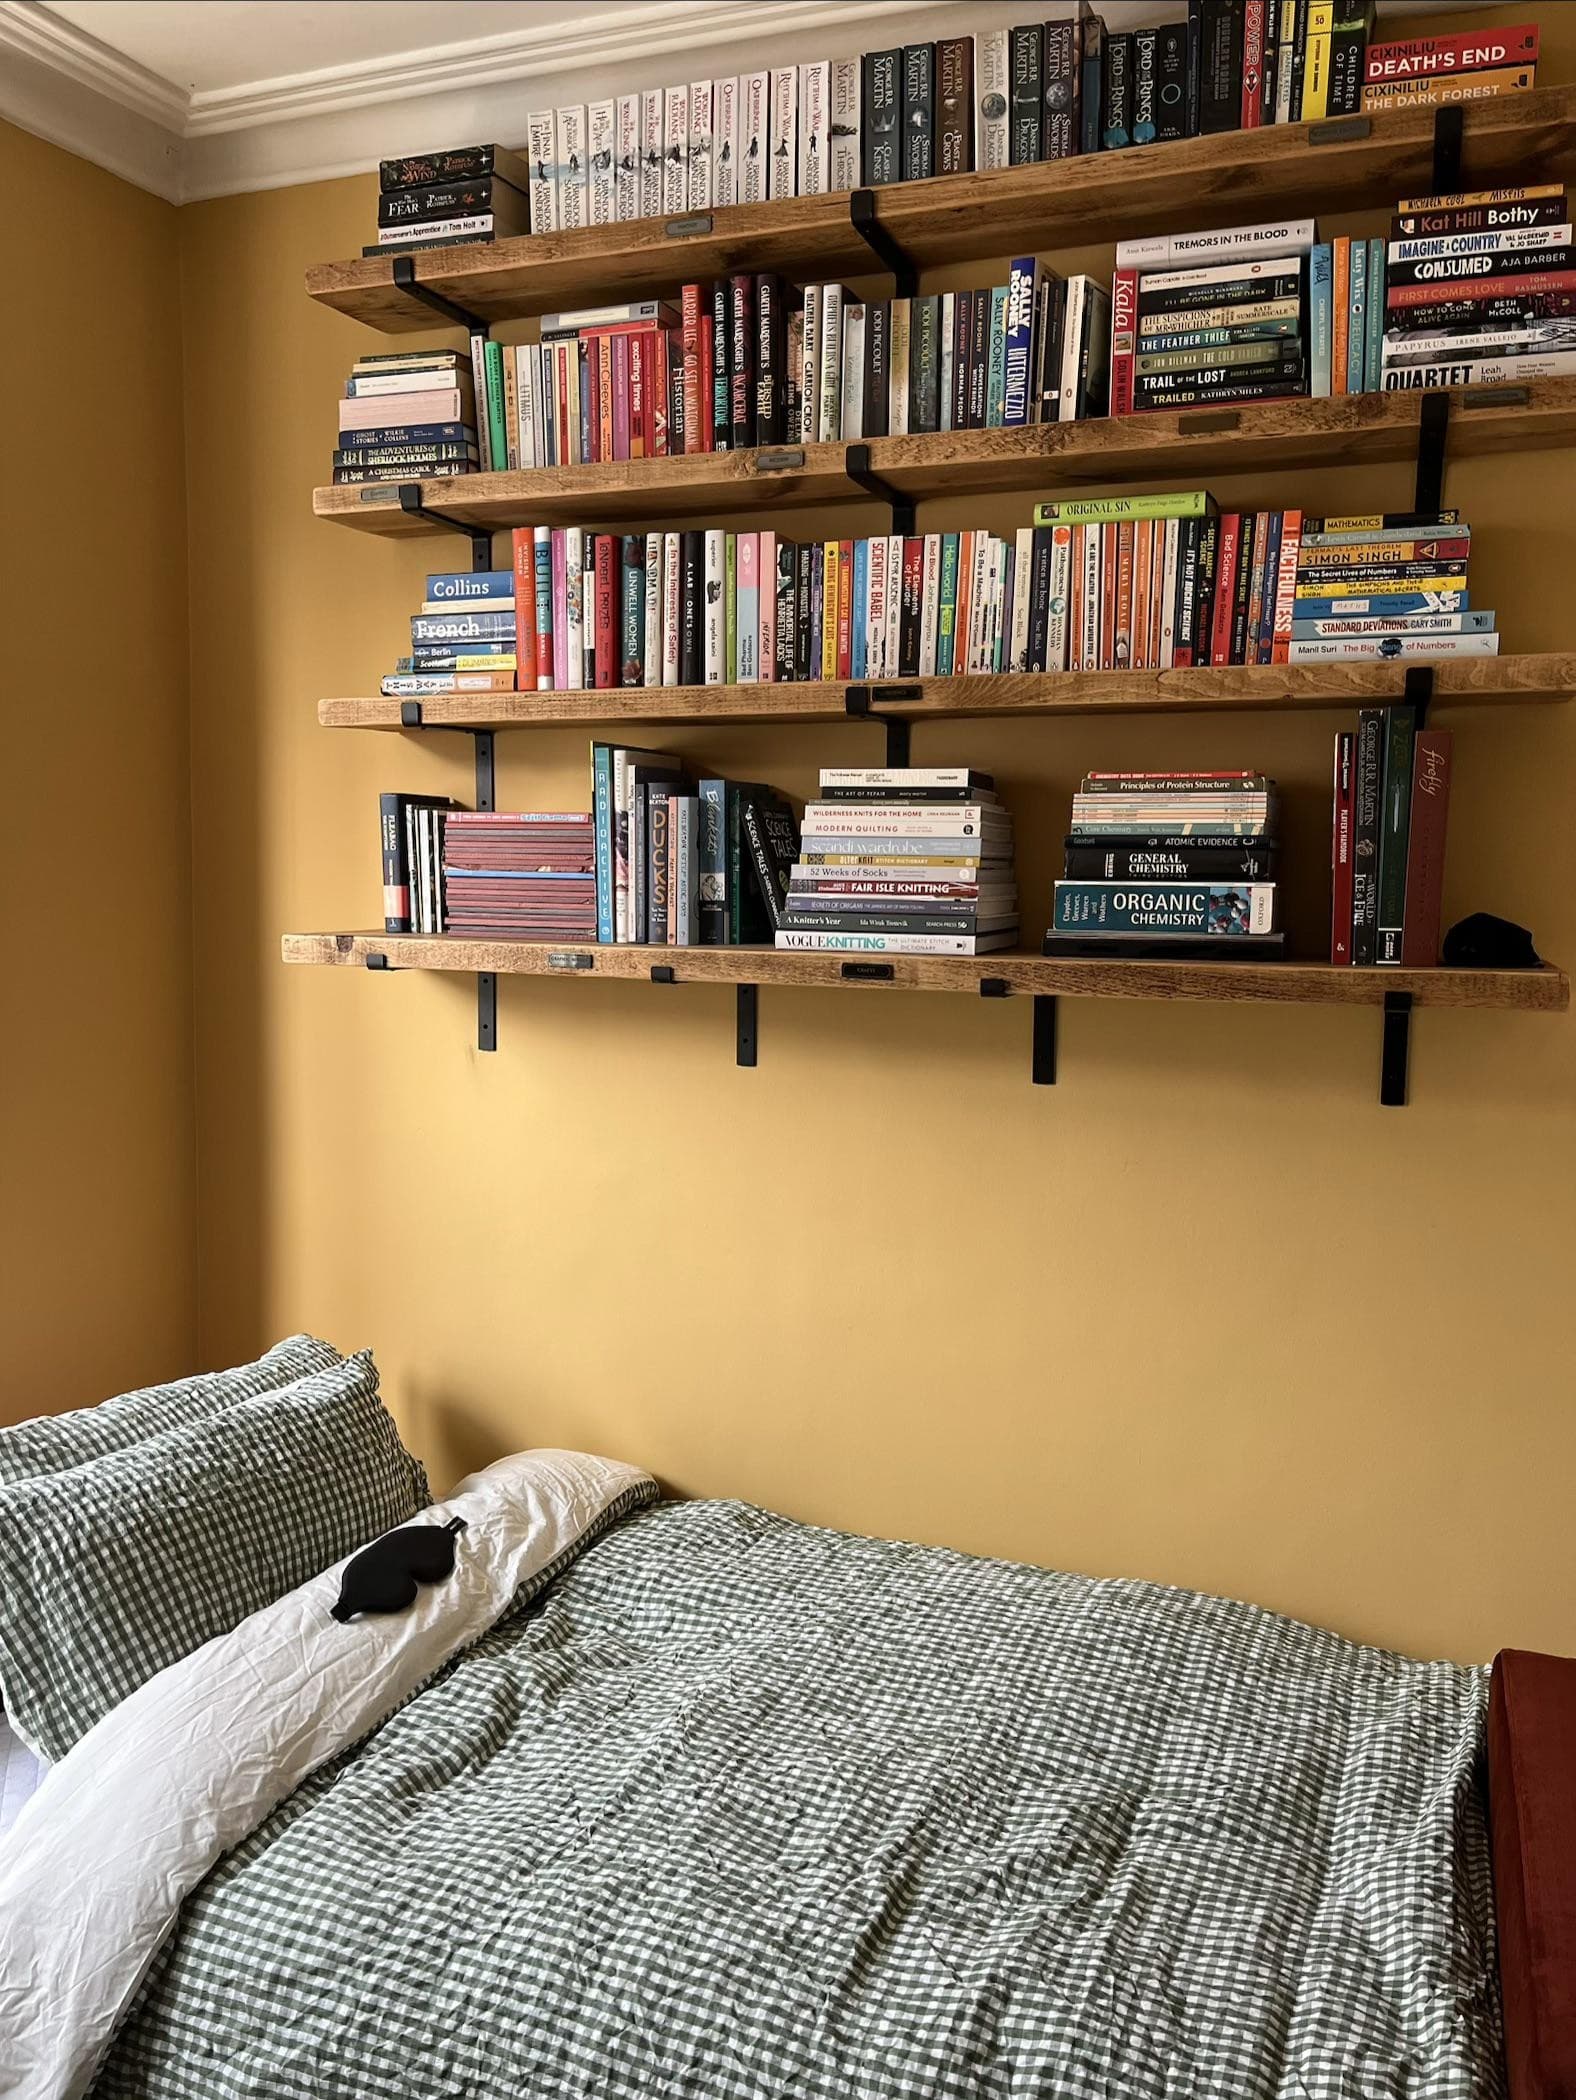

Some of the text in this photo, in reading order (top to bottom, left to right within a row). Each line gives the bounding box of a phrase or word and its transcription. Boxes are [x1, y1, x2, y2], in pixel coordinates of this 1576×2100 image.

[1315, 15, 1324, 25] 50
[1248, 4, 1261, 65] POWER
[1017, 32, 1028, 84] MARTIN
[1050, 28, 1063, 80] MARTIN
[1369, 46, 1506, 77] DEATH'S END
[908, 51, 920, 102] MARTIN
[943, 45, 954, 97] MARTIN
[1136, 36, 1155, 123] LORD RINGS
[1333, 53, 1344, 103] OF TIME
[1345, 46, 1358, 109] CHILDREN
[838, 64, 848, 115] MARTIN
[874, 59, 885, 109] MARTIN
[1365, 85, 1499, 110] THE DARK FOREST
[943, 132, 953, 171] CROWS
[837, 146, 847, 191] THRONE
[543, 187, 551, 231] BRANDON
[1421, 206, 1539, 232] Kat Hill Bothy
[449, 221, 476, 231] Tom Holt
[1174, 237, 1218, 251] TREMORS
[1220, 235, 1231, 245] IN
[1234, 232, 1252, 242] THE
[1254, 229, 1288, 240] BLOOD
[1399, 234, 1502, 259] IMAGINE COUNTRY
[1414, 253, 1566, 279] CONSUMED AJA BARBER
[1008, 269, 1021, 338] ROONEY
[1019, 275, 1032, 328] SALLY
[1115, 279, 1134, 329] Kala
[1399, 283, 1505, 302] FIRST COMES LOVE
[992, 297, 1003, 376] SALLY ROONEY
[1141, 330, 1231, 351] THE FEATHER THIEF
[1351, 318, 1363, 375] DELICACY
[1395, 340, 1446, 351] PAPYRUS
[873, 334, 882, 375] PICOULT
[631, 341, 642, 412] exciting times
[1143, 370, 1226, 390] TRAIL LOST
[1386, 365, 1473, 390] QUARTET
[1481, 366, 1502, 375] Leah
[1005, 347, 1027, 420] INTERMEZZO
[520, 384, 531, 422] LITMUS
[1152, 392, 1195, 404] TRAILED
[1067, 501, 1131, 515] ORIGINAL SIN
[1327, 518, 1381, 529] MATHEMATICS
[1222, 535, 1233, 586] Bad Science
[1306, 551, 1401, 565] SIMON SINGH
[434, 579, 490, 597] Collins
[871, 543, 884, 622] SCIENTIFIC BABEL
[911, 574, 920, 616] Elements
[1275, 539, 1299, 633] FACTFULNESS
[628, 571, 638, 656] UNWELL WOMEN
[1322, 620, 1362, 633] STANDARD
[1363, 619, 1408, 632] DEVIATIONS
[416, 616, 480, 639] French
[431, 648, 452, 656] Berlin
[1361, 644, 1375, 653] Big
[1407, 641, 1456, 650] of Numbers
[1419, 747, 1445, 797] firefly
[1120, 780, 1230, 790] Principles of Protein Structure
[856, 825, 898, 833] QUILTING
[1165, 838, 1238, 846] ATOMIC EVIDENCE
[653, 809, 666, 905] DUCKS
[1128, 863, 1189, 874] CHEMISTRY
[1129, 853, 1181, 864] GENERAL
[810, 868, 888, 877] 52 Weeks of Socks
[851, 883, 949, 894] FAIR ISLE KNITTING
[1113, 892, 1205, 911] ORGANIC
[786, 915, 792, 924] A
[1131, 913, 1204, 926] CHEMISTRY
[785, 933, 886, 949] VOGUE KNITTING
